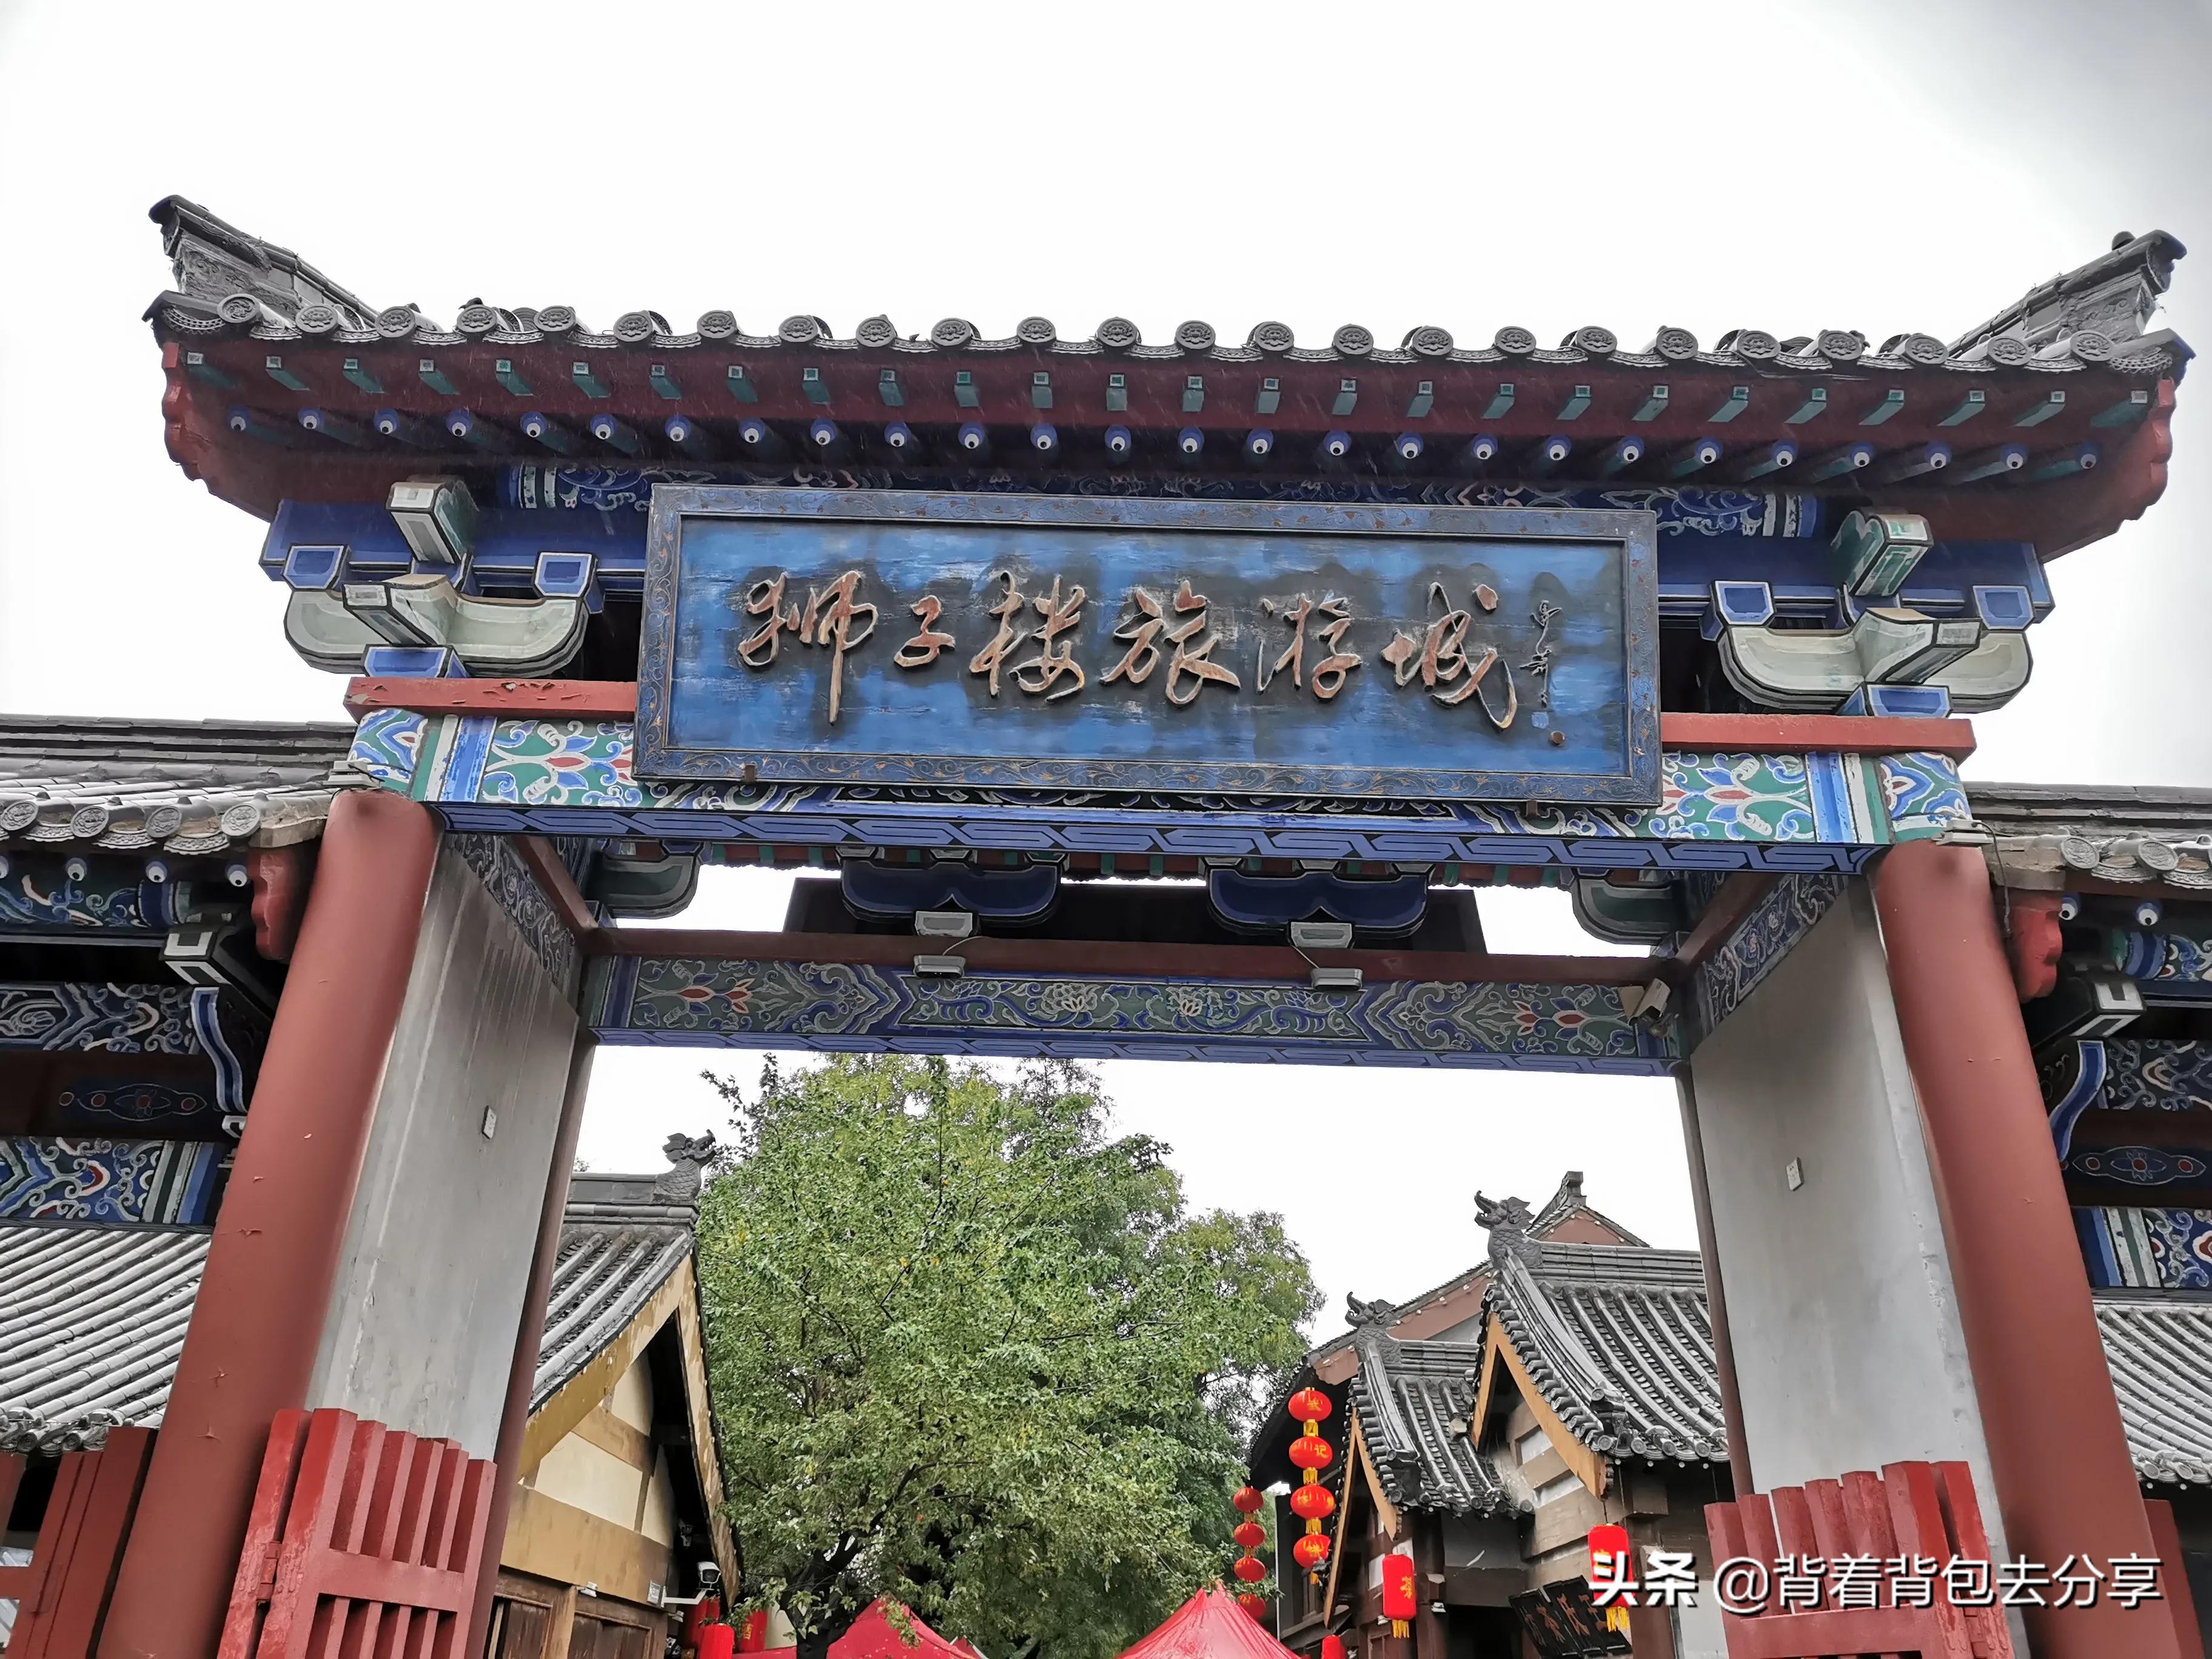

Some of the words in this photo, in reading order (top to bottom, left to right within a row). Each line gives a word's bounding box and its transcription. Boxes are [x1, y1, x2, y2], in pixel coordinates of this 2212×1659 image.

[737, 569, 1517, 729] 狮子楼旅游城
[1313, 1444, 1330, 1459] 记
